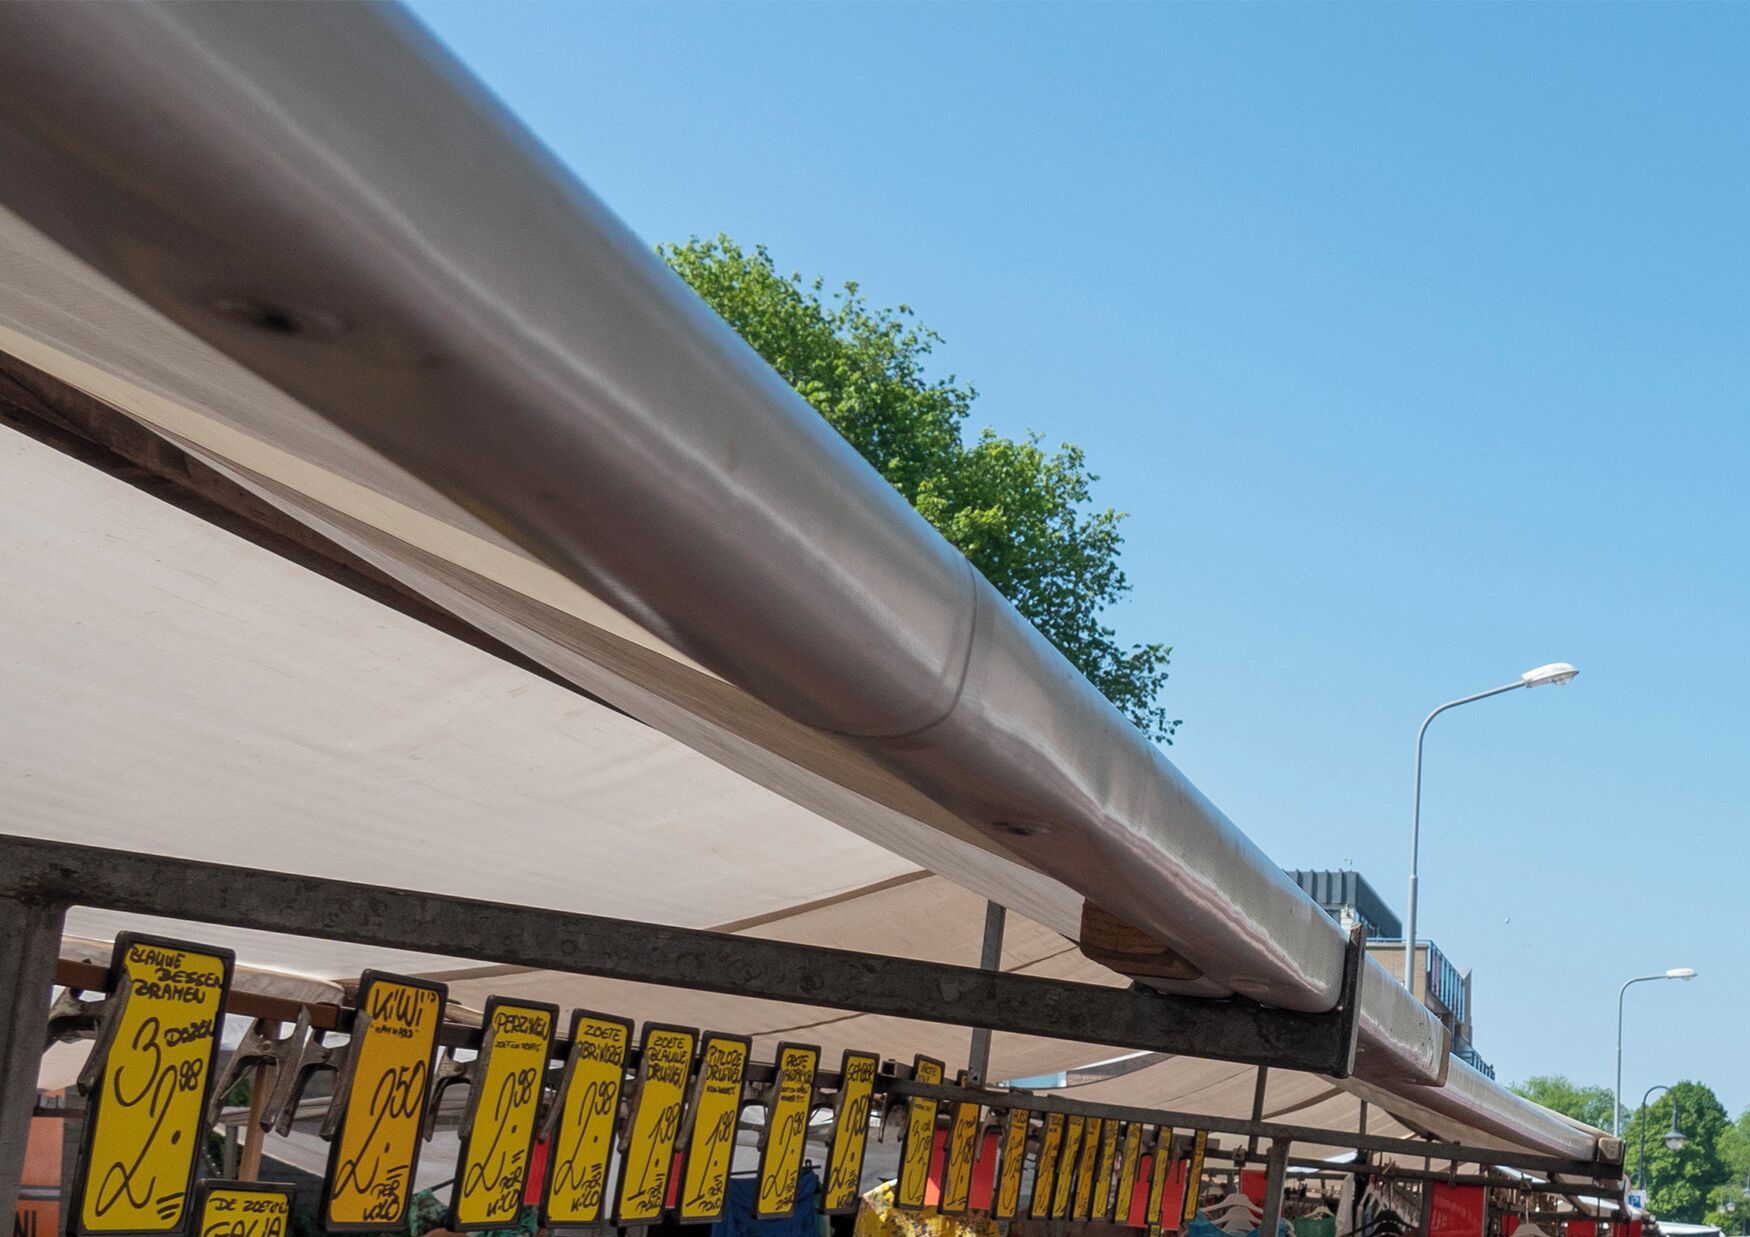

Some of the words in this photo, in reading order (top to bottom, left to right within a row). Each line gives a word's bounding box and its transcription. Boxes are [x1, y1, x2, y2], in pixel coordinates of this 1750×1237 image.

[132, 978, 205, 1004] BRAMEN
[584, 1025, 622, 1042] ZOETE
[653, 1036, 685, 1049] ZOETE
